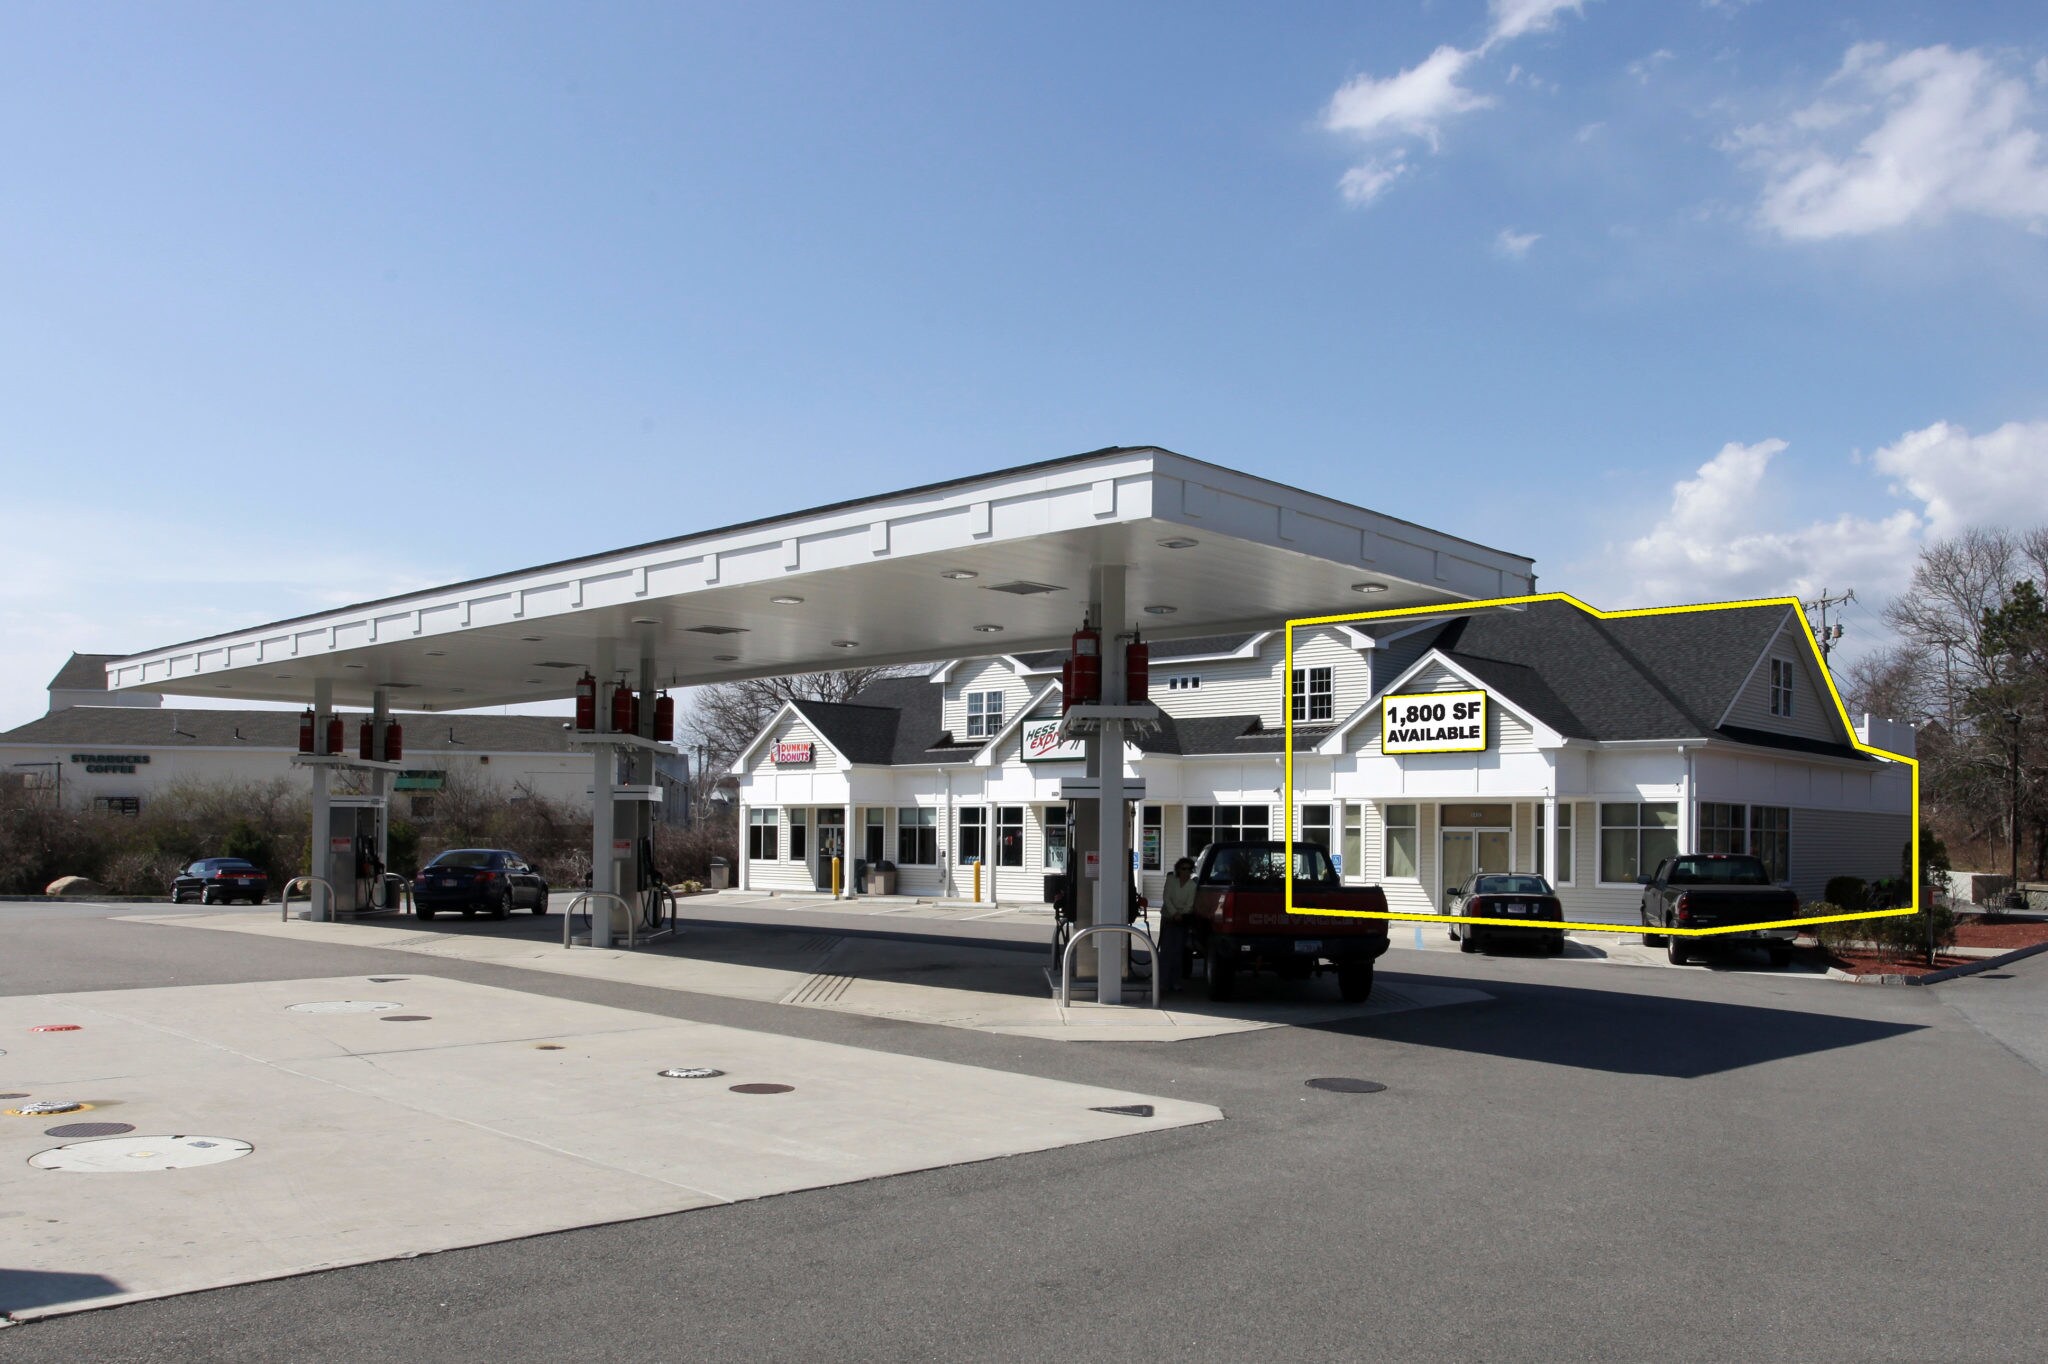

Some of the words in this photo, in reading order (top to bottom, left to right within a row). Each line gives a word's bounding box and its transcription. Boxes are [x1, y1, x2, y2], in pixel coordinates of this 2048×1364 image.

[1026, 722, 1058, 742] HESS
[71, 754, 151, 764] STARBUCKS
[781, 752, 809, 762] DONUTS
[86, 764, 136, 774] COFFEE
